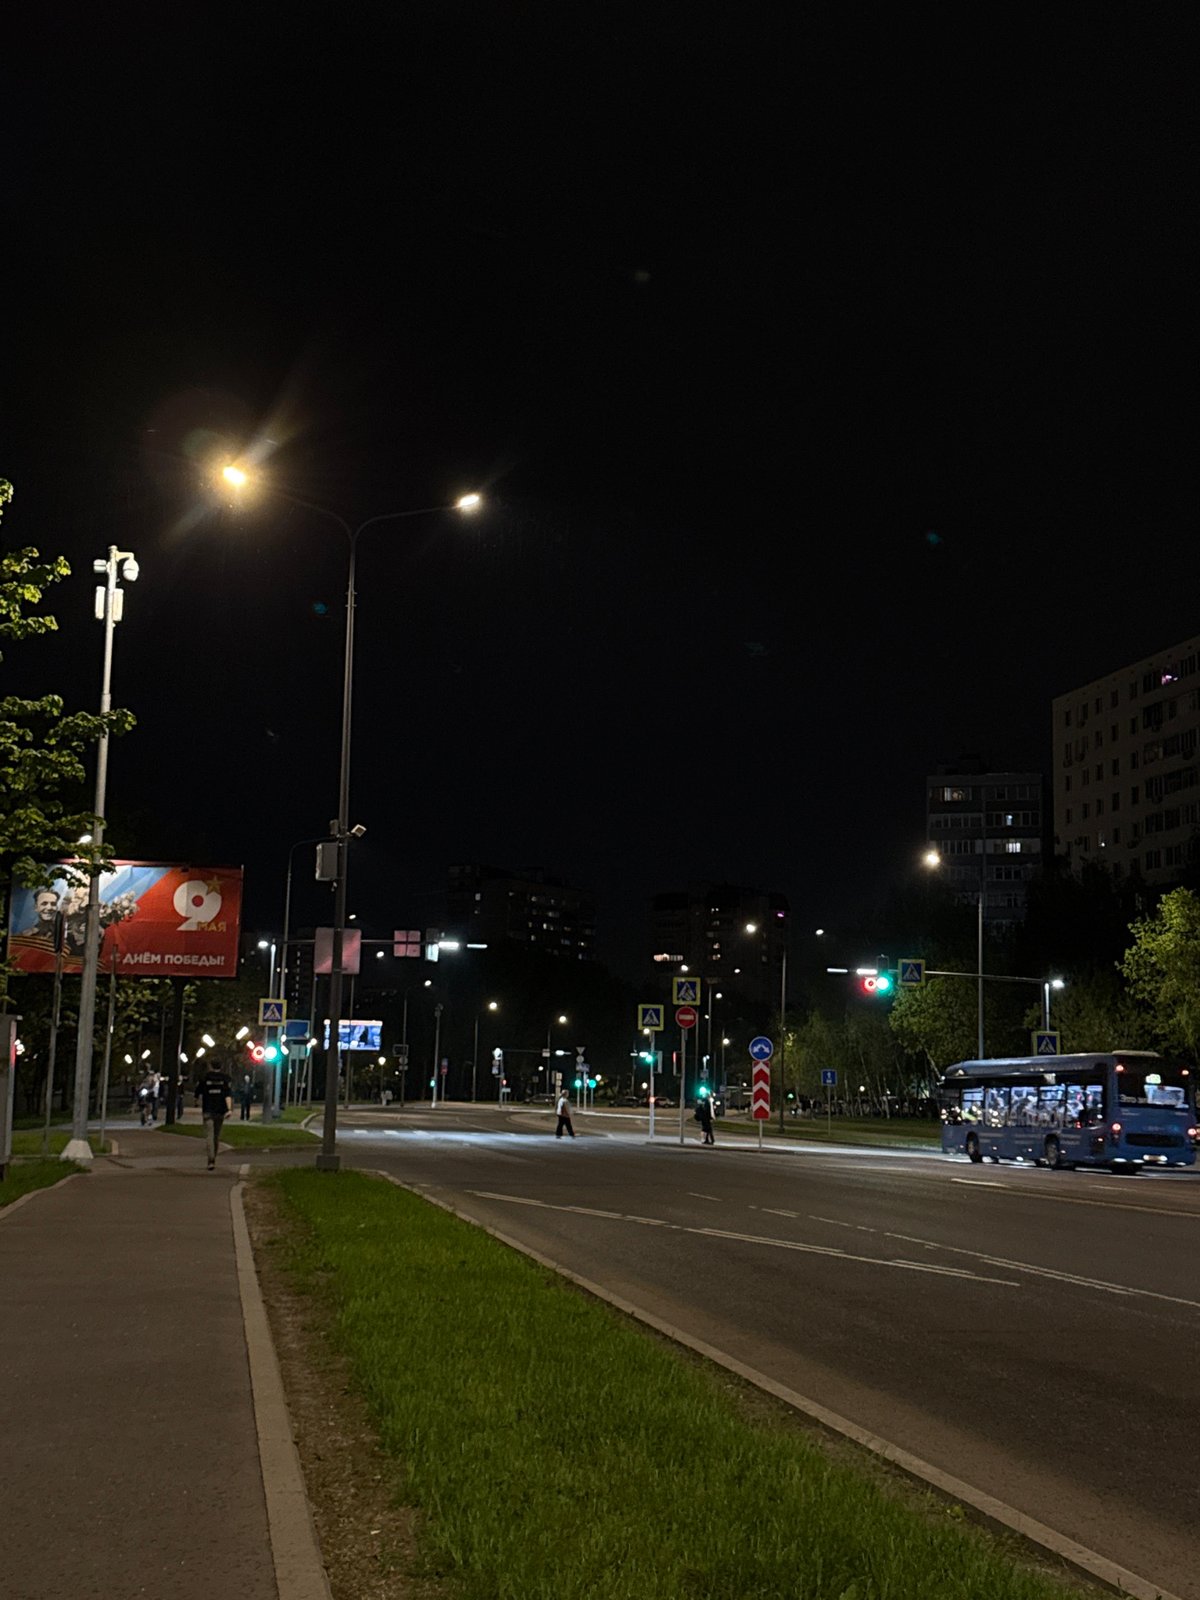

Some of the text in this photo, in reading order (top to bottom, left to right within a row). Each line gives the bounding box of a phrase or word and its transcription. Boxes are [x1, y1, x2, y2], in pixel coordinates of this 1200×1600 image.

[173, 880, 222, 931] 9
[197, 920, 227, 933] МАЯ
[122, 951, 161, 965] ДНЁМ
[164, 954, 225, 967] ПОБЕДЫ!
